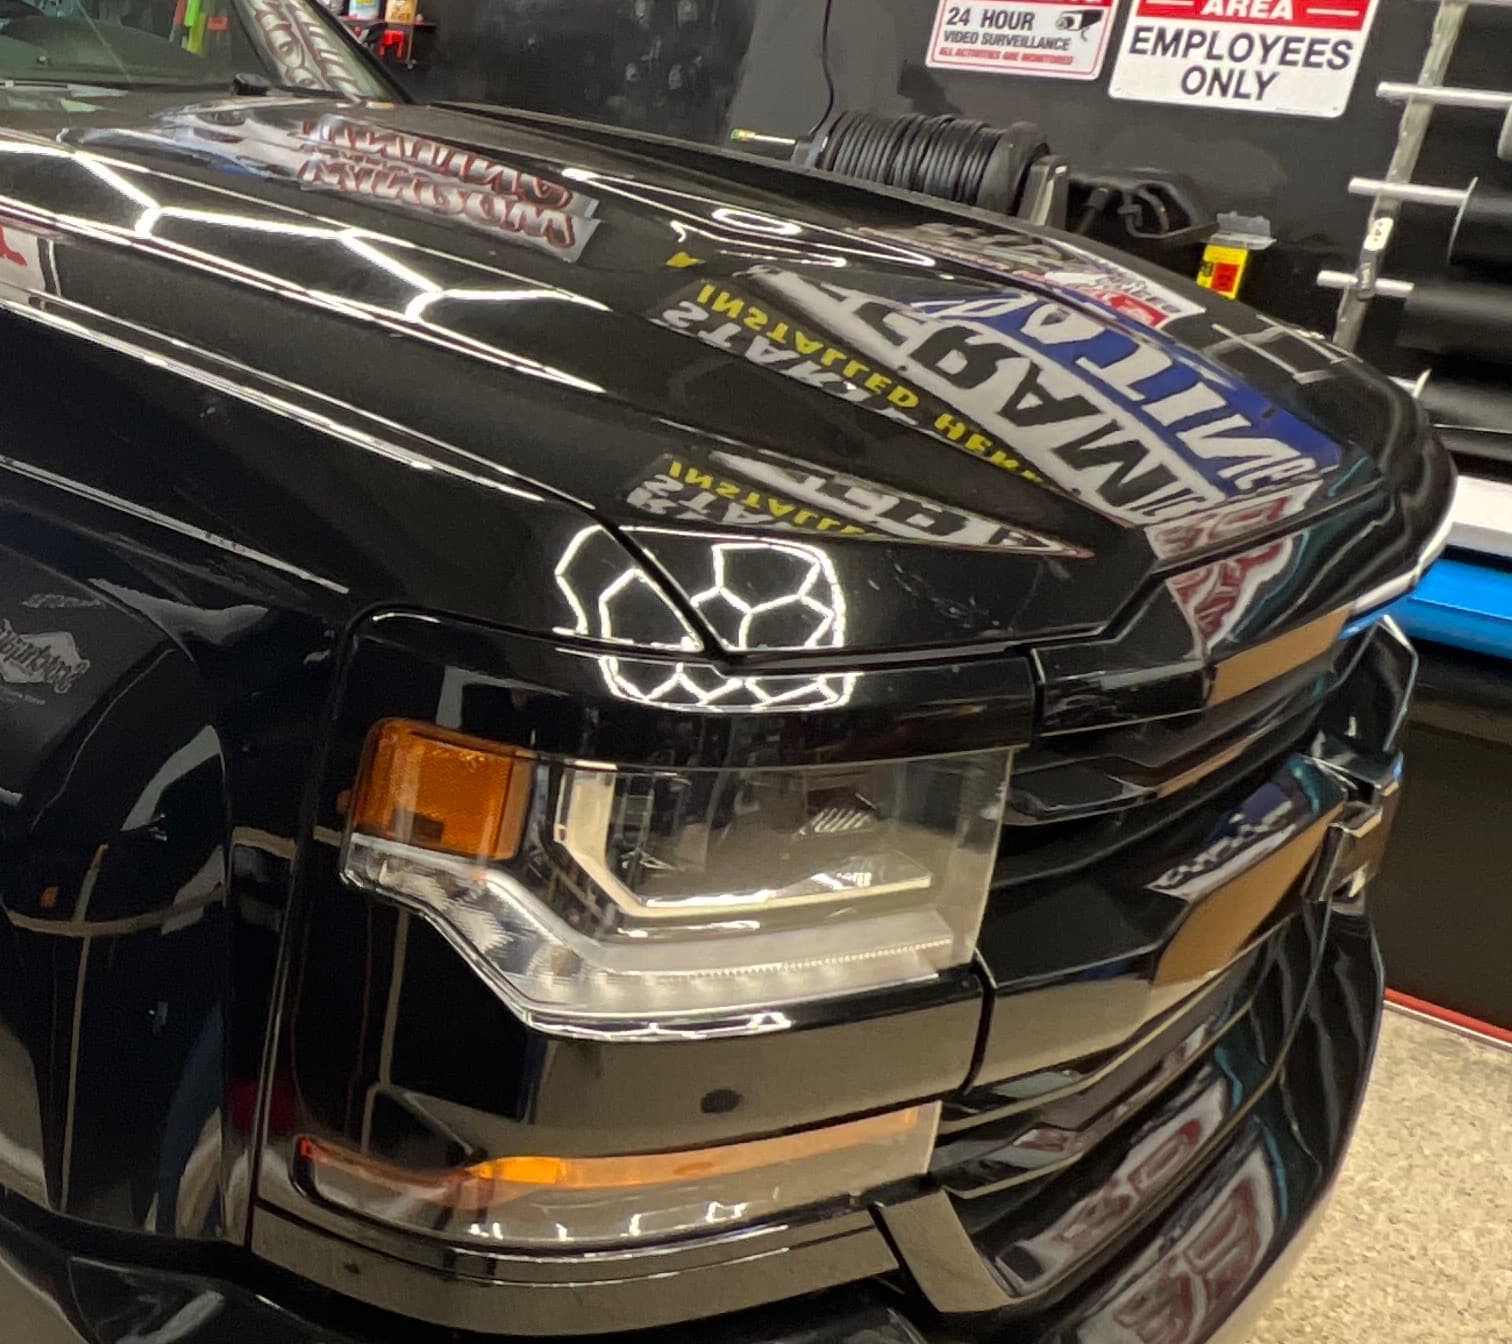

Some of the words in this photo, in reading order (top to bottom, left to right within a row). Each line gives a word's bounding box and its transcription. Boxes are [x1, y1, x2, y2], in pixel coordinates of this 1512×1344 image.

[945, 6, 971, 27] 24
[980, 9, 1036, 32] HOUR
[943, 30, 979, 45] VIDEO
[981, 32, 1072, 52] SURVEILLANCE
[1128, 25, 1354, 71] EMPLOYEES
[1179, 65, 1280, 102] ONLY
